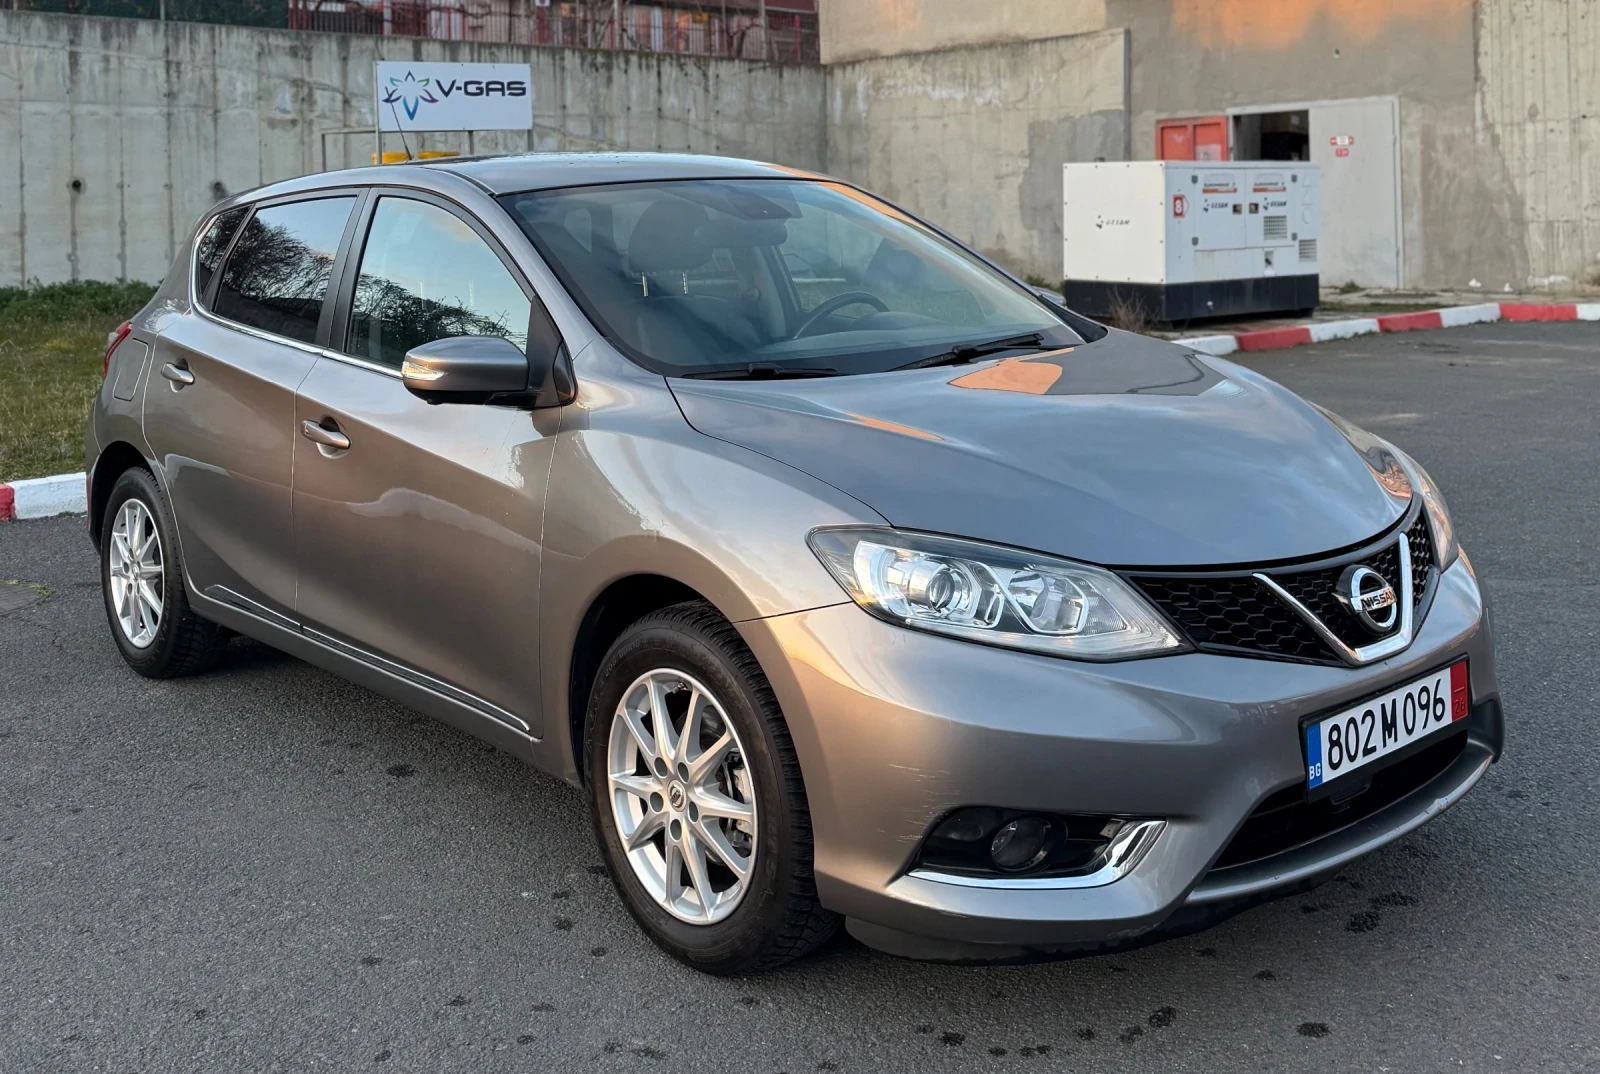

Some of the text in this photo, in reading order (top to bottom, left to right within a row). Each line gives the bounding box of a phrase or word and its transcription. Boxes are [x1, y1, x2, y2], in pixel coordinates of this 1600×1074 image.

[435, 79, 526, 98] V-GAS
[1361, 589, 1394, 611] NISSAN
[1309, 763, 1322, 780] BG
